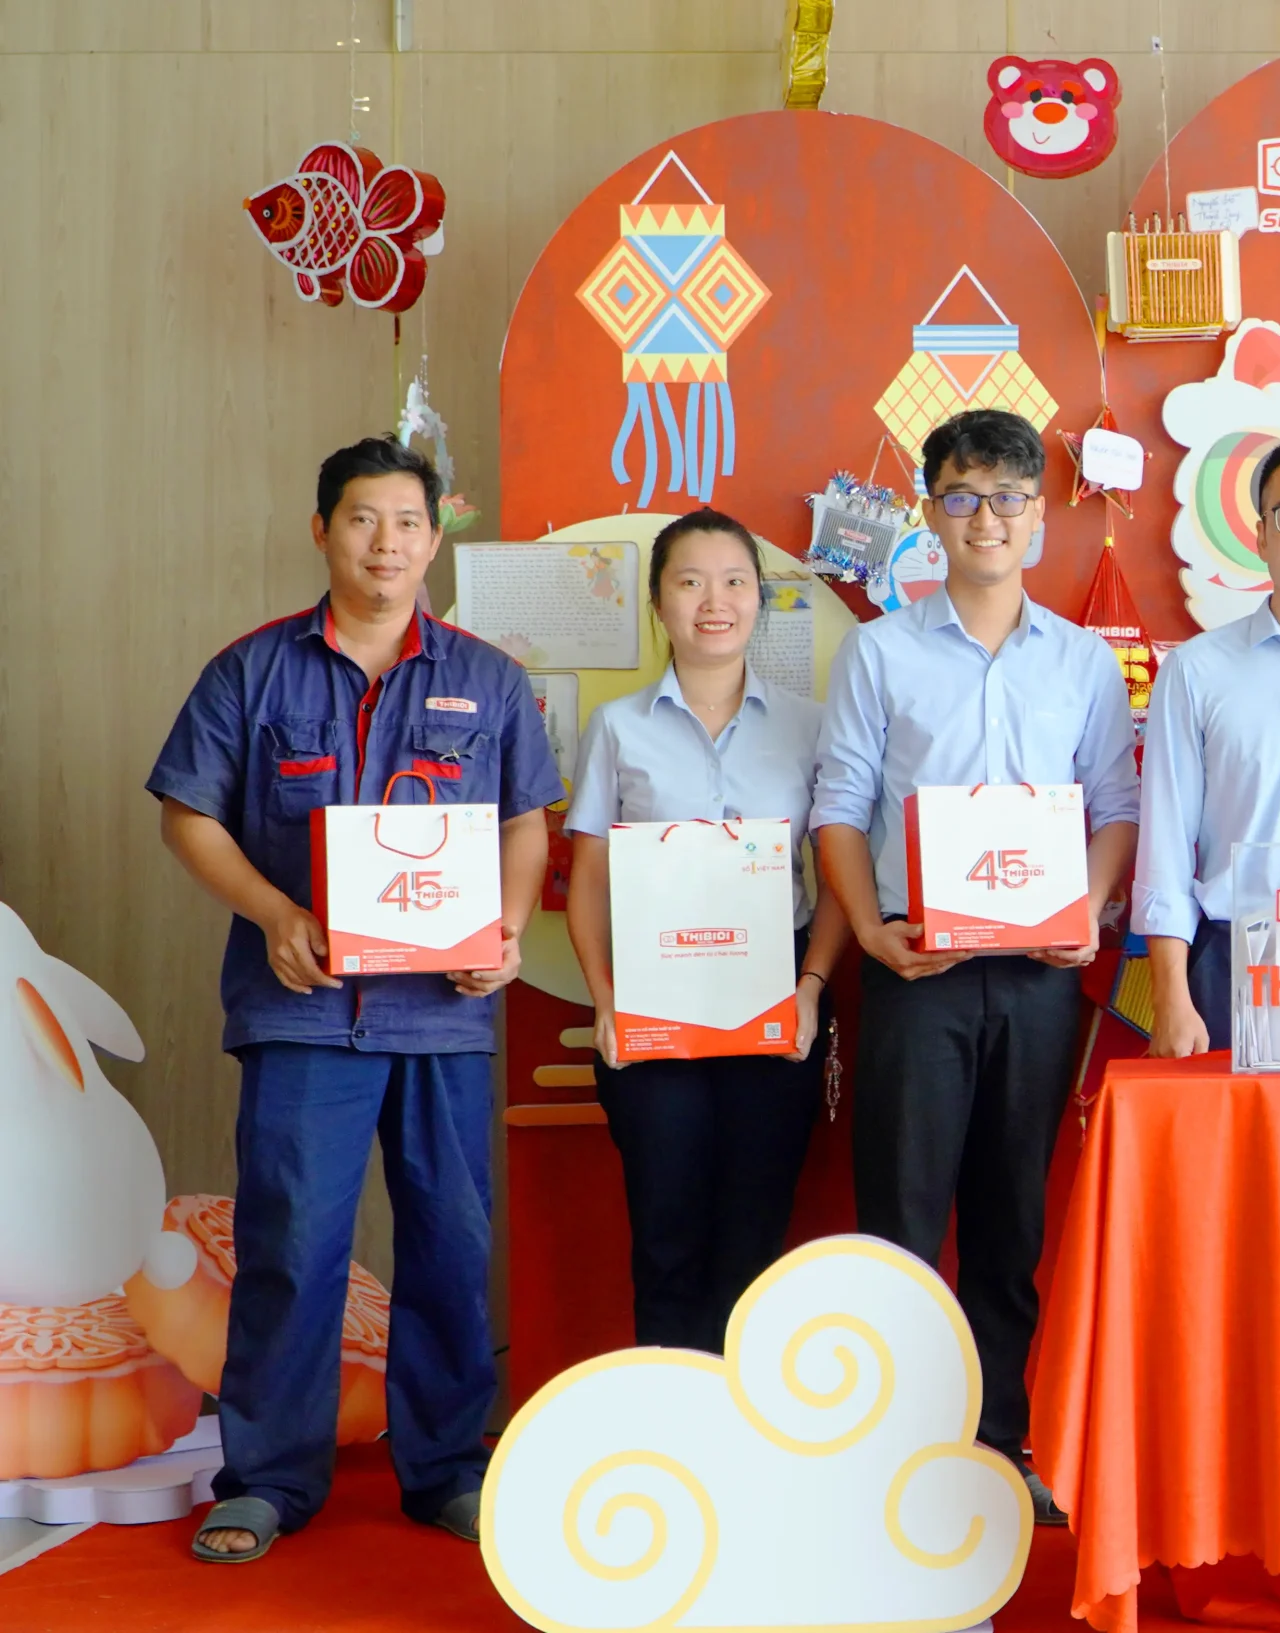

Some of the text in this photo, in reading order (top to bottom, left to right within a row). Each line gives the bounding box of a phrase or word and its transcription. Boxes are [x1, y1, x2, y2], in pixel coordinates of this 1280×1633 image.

[966, 850, 1045, 890] 45 THIBIDI
[377, 871, 460, 913] 45 THIBIDI
[680, 931, 731, 942] THIBIDI
